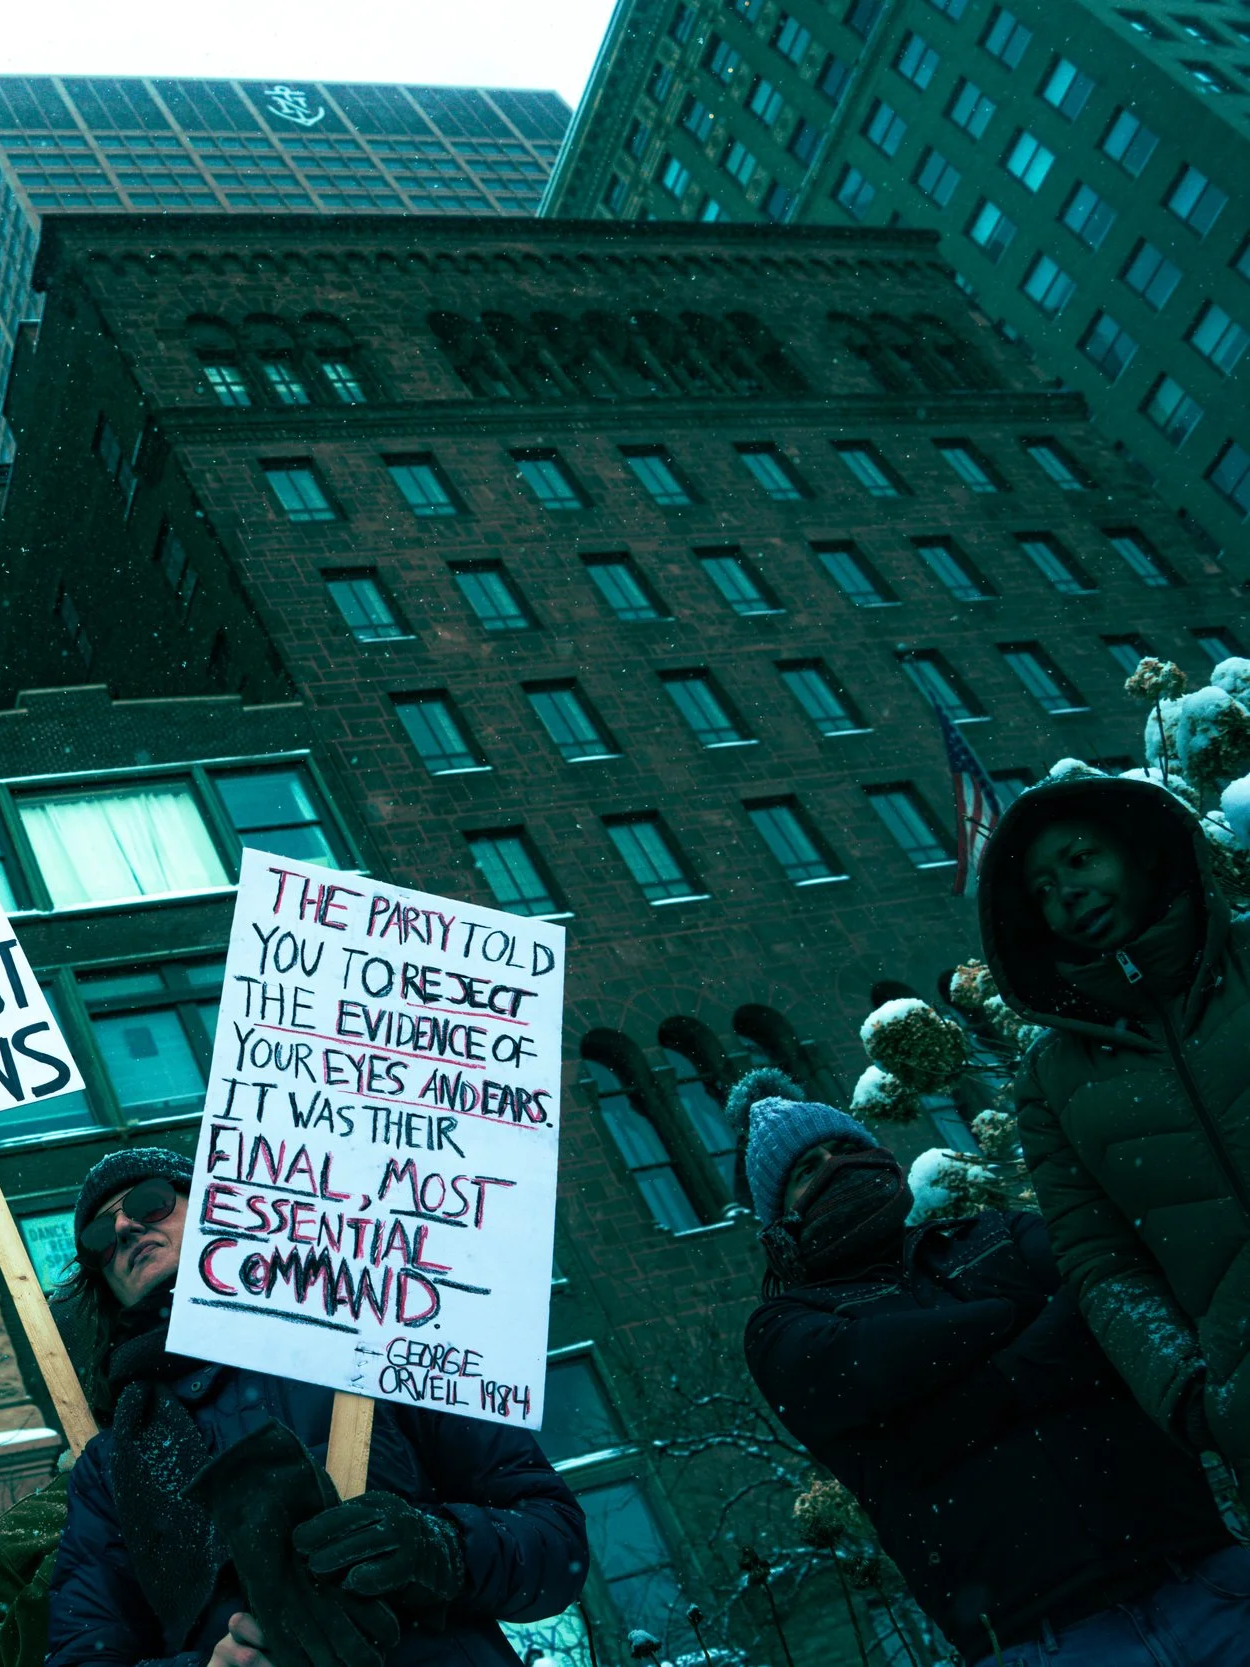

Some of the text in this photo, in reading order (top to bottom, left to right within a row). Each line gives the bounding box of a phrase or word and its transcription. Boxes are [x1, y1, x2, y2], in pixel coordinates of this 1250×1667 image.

[252, 922, 324, 976] YOU
[267, 867, 556, 977] THE PARTY TOLD
[234, 975, 538, 1069] THE EVIDENCE OF
[234, 1021, 317, 1083] YOUR
[323, 1048, 410, 1095] EYES
[418, 1067, 481, 1112] AND
[212, 1077, 466, 1158] IT WAS THEIR
[206, 1123, 518, 1230] FINAL, MOST
[200, 1182, 453, 1275] ESSENTIAL
[480, 1379, 531, 1420] 1984
